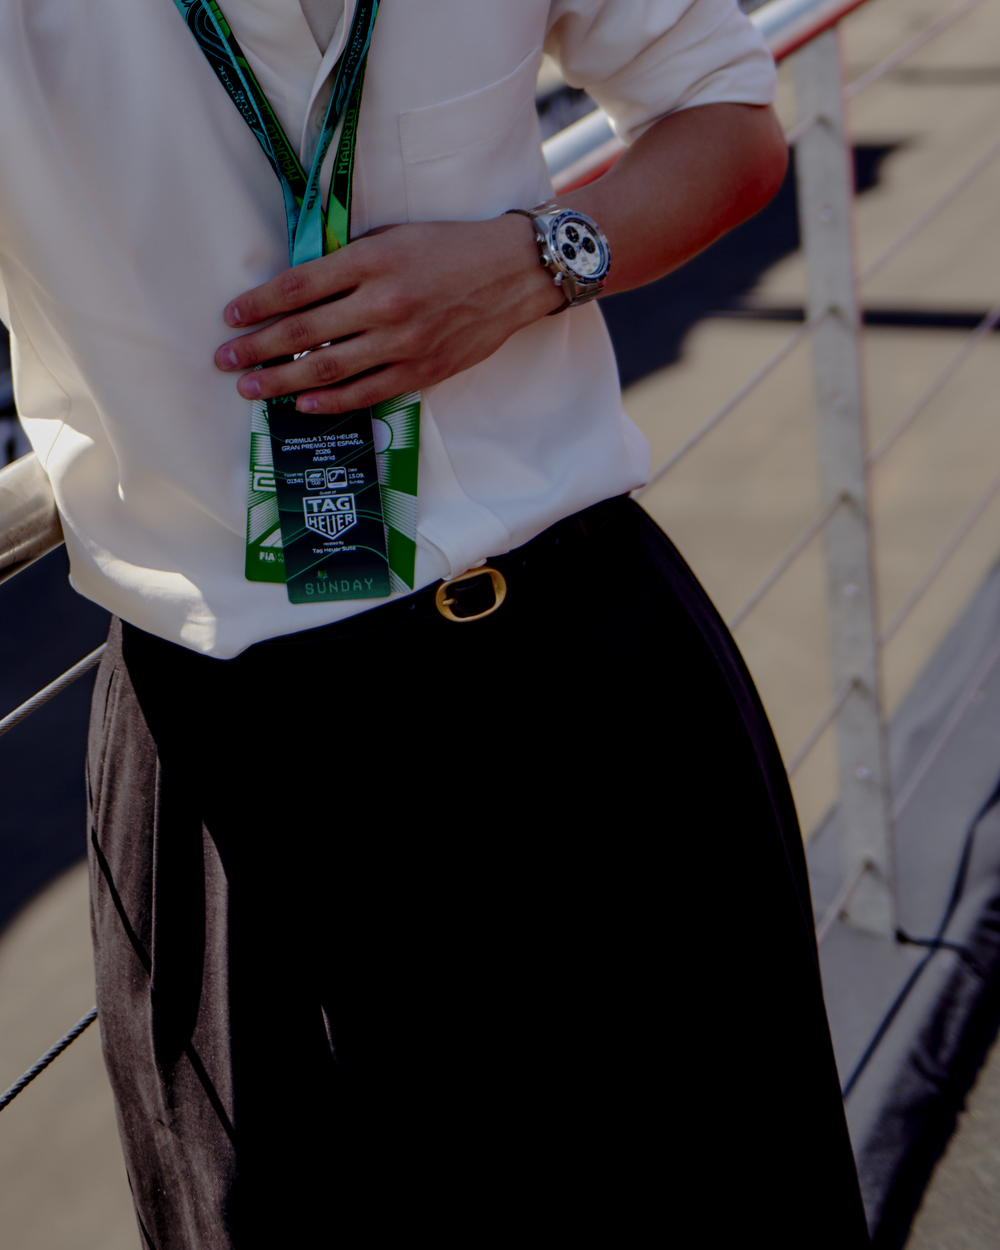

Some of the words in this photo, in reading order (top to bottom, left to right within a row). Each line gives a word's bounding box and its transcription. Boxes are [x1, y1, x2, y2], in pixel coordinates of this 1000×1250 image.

[344, 7, 366, 72] PADDOCK
[218, 65, 252, 124] PADDOCK
[238, 90, 256, 123] CLUB
[266, 124, 300, 181] MADRID
[337, 109, 356, 174] MADRID
[285, 436, 317, 444] FORMULA
[301, 442, 326, 450] PREMIO
[337, 439, 364, 447] ESPAÑA
[307, 497, 350, 513] TAG
[308, 514, 353, 536] HEUER
[305, 578, 374, 595] SUNDAY
